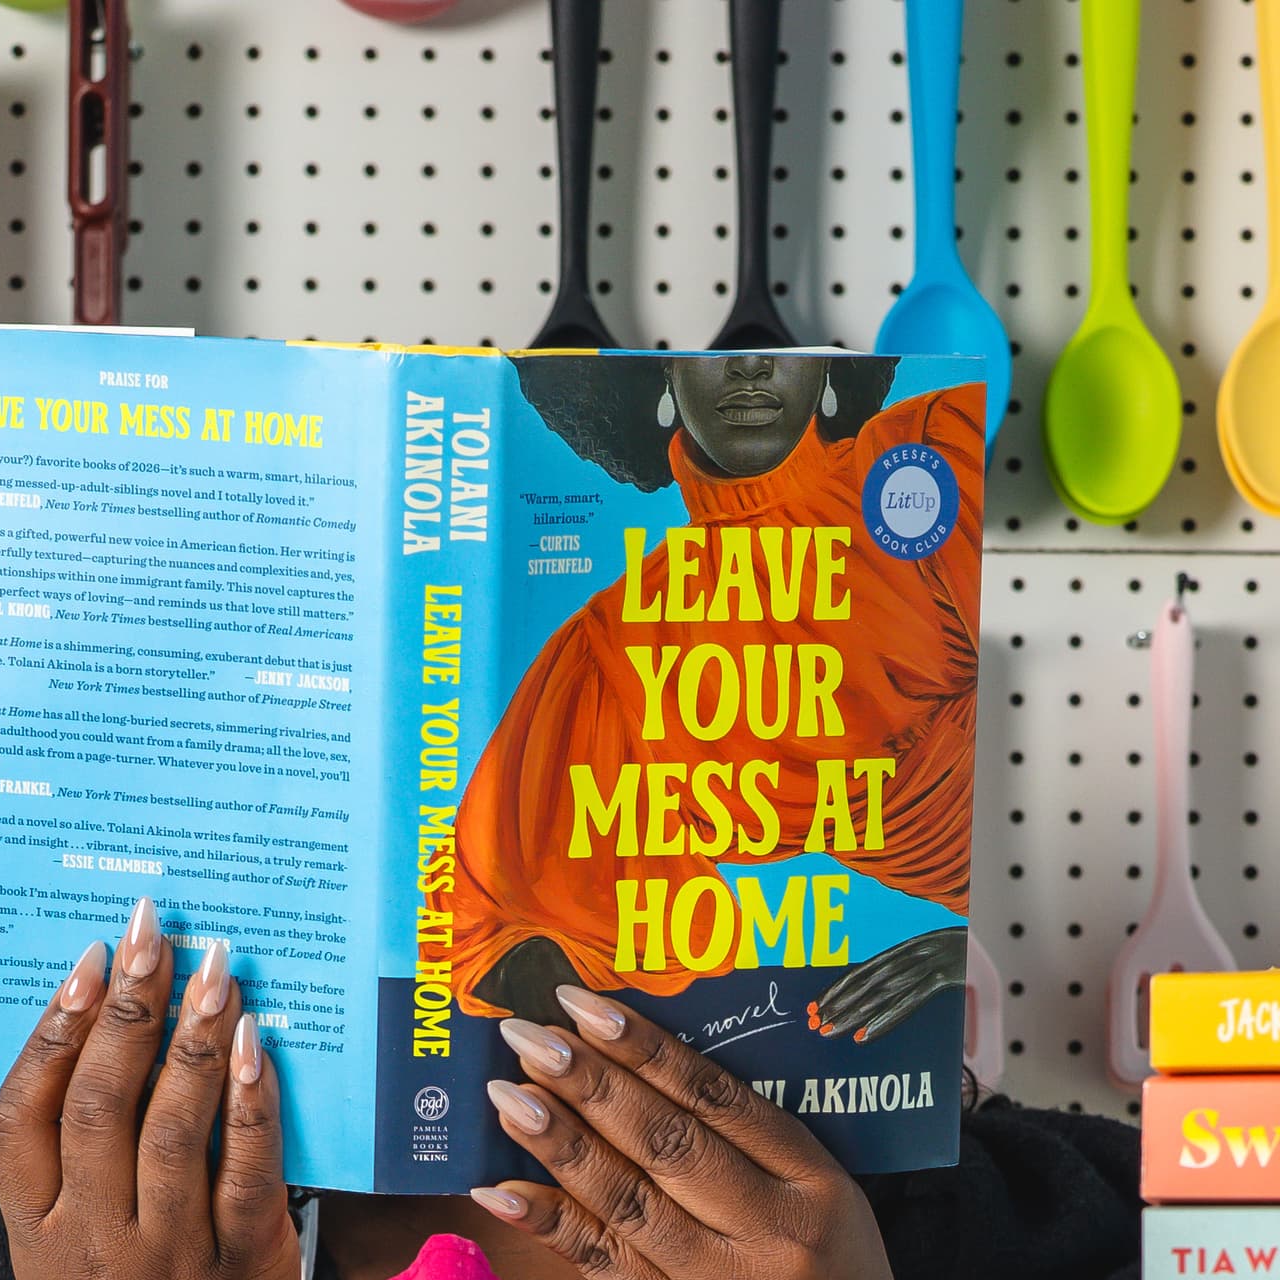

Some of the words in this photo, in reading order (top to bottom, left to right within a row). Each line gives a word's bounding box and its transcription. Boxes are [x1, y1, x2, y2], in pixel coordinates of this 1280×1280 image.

[100, 371, 140, 387] PRAISE
[145, 374, 168, 388] FOR
[35, 398, 109, 433] YOUR
[120, 403, 190, 439] MESS
[201, 409, 235, 441] AT
[245, 411, 323, 447] HOME
[14, 480, 158, 497] messed-up-adult-siblings
[161, 488, 192, 499] novel
[194, 490, 215, 500] and
[217, 490, 222, 500] I
[225, 492, 262, 505] totally
[266, 493, 296, 505] loved
[36, 455, 80, 468] favorite
[83, 458, 116, 470] books
[118, 461, 130, 471] of
[189, 467, 216, 477] such
[226, 471, 263, 480] warm,
[265, 473, 302, 484] smart,
[304, 473, 358, 488] hilarious,
[403, 391, 444, 556] AKINOLA
[450, 408, 490, 542] TOLANI
[45, 499, 70, 510] New
[72, 501, 98, 512] York
[100, 502, 135, 514] Times
[138, 505, 200, 520] bestselling
[202, 510, 240, 521] author
[242, 512, 256, 523] of
[256, 514, 311, 526] Romantic
[313, 518, 356, 532] Comedy
[564, 491, 604, 505] smart,
[874, 526, 908, 554] BOOK
[916, 524, 947, 552] CLUB
[528, 558, 592, 575] SITTENFELD
[621, 526, 852, 623] LEAVE
[423, 584, 462, 686] LEAVE
[625, 644, 846, 742] YOUR
[419, 698, 459, 791] YOUR
[0, 780, 56, 798] FRANKEL,
[58, 787, 82, 798] New
[85, 790, 111, 800] York
[114, 792, 148, 803] Times
[150, 794, 212, 810] bestselling
[215, 800, 253, 812] author
[255, 803, 270, 813] of
[270, 804, 308, 818] Family
[311, 808, 349, 822] Family
[568, 759, 780, 858] MESS
[805, 758, 896, 852] AT
[417, 804, 456, 894] MESS
[416, 906, 454, 948] AT
[614, 874, 850, 972] HOME
[412, 960, 453, 1058] HOME
[702, 980, 791, 1037] novel
[798, 1072, 934, 1114] AKINOLA
[1172, 1248, 1234, 1274] TIA
